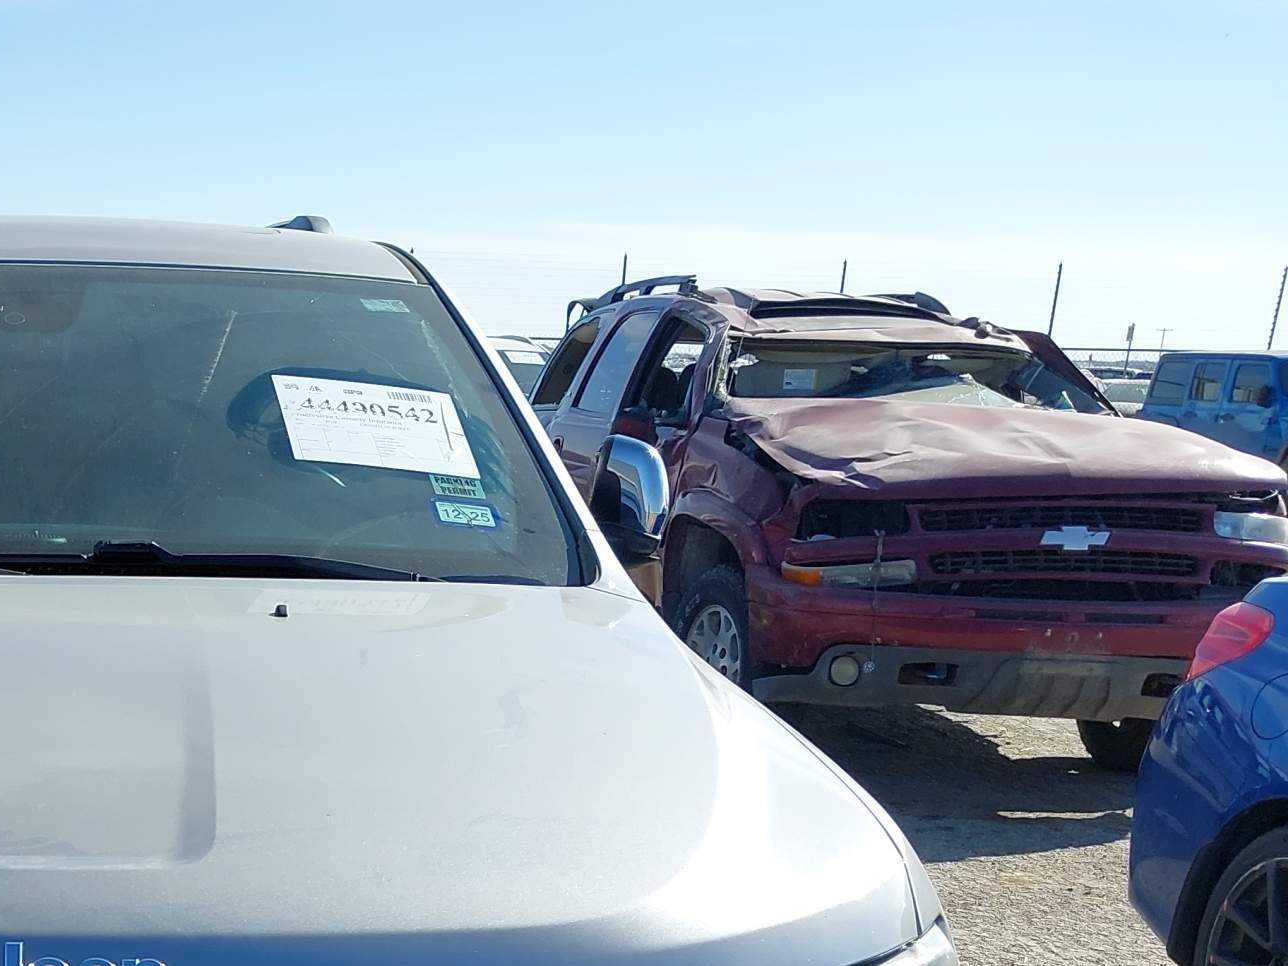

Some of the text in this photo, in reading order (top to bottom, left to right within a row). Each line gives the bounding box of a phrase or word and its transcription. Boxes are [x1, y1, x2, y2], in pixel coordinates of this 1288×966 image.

[300, 397, 438, 424] 44490542
[441, 486, 477, 497] PERMIT
[442, 508, 490, 522] 12 25
